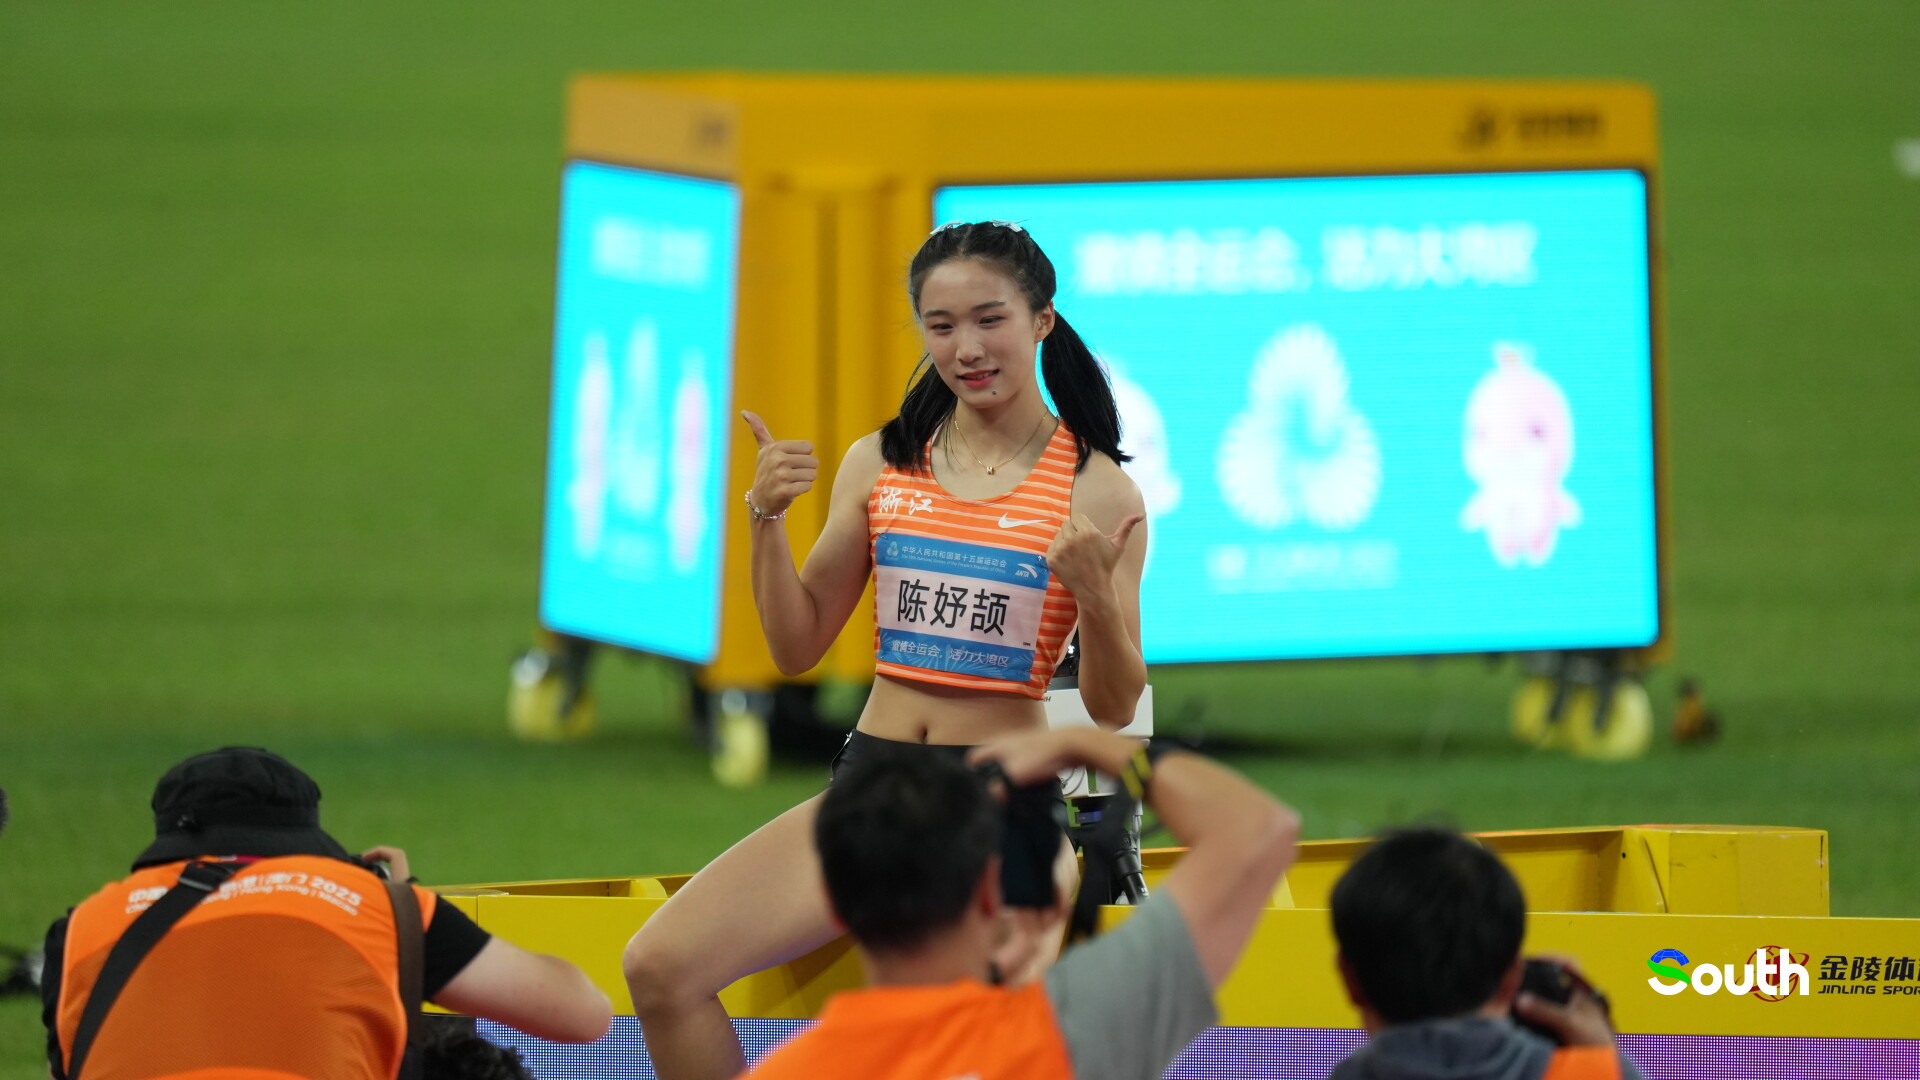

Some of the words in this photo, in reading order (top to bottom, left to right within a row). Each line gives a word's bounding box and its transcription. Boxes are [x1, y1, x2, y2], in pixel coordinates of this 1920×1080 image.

[879, 487, 934, 519] 浙江
[902, 546, 1007, 568] 中华人民共和国第十五届运动会
[1015, 570, 1030, 578] ANTA
[897, 578, 1010, 637] 陈妤颉
[310, 876, 362, 907] 2025
[1818, 955, 1920, 981] 金陵体
[1818, 985, 1876, 995] JINLING
